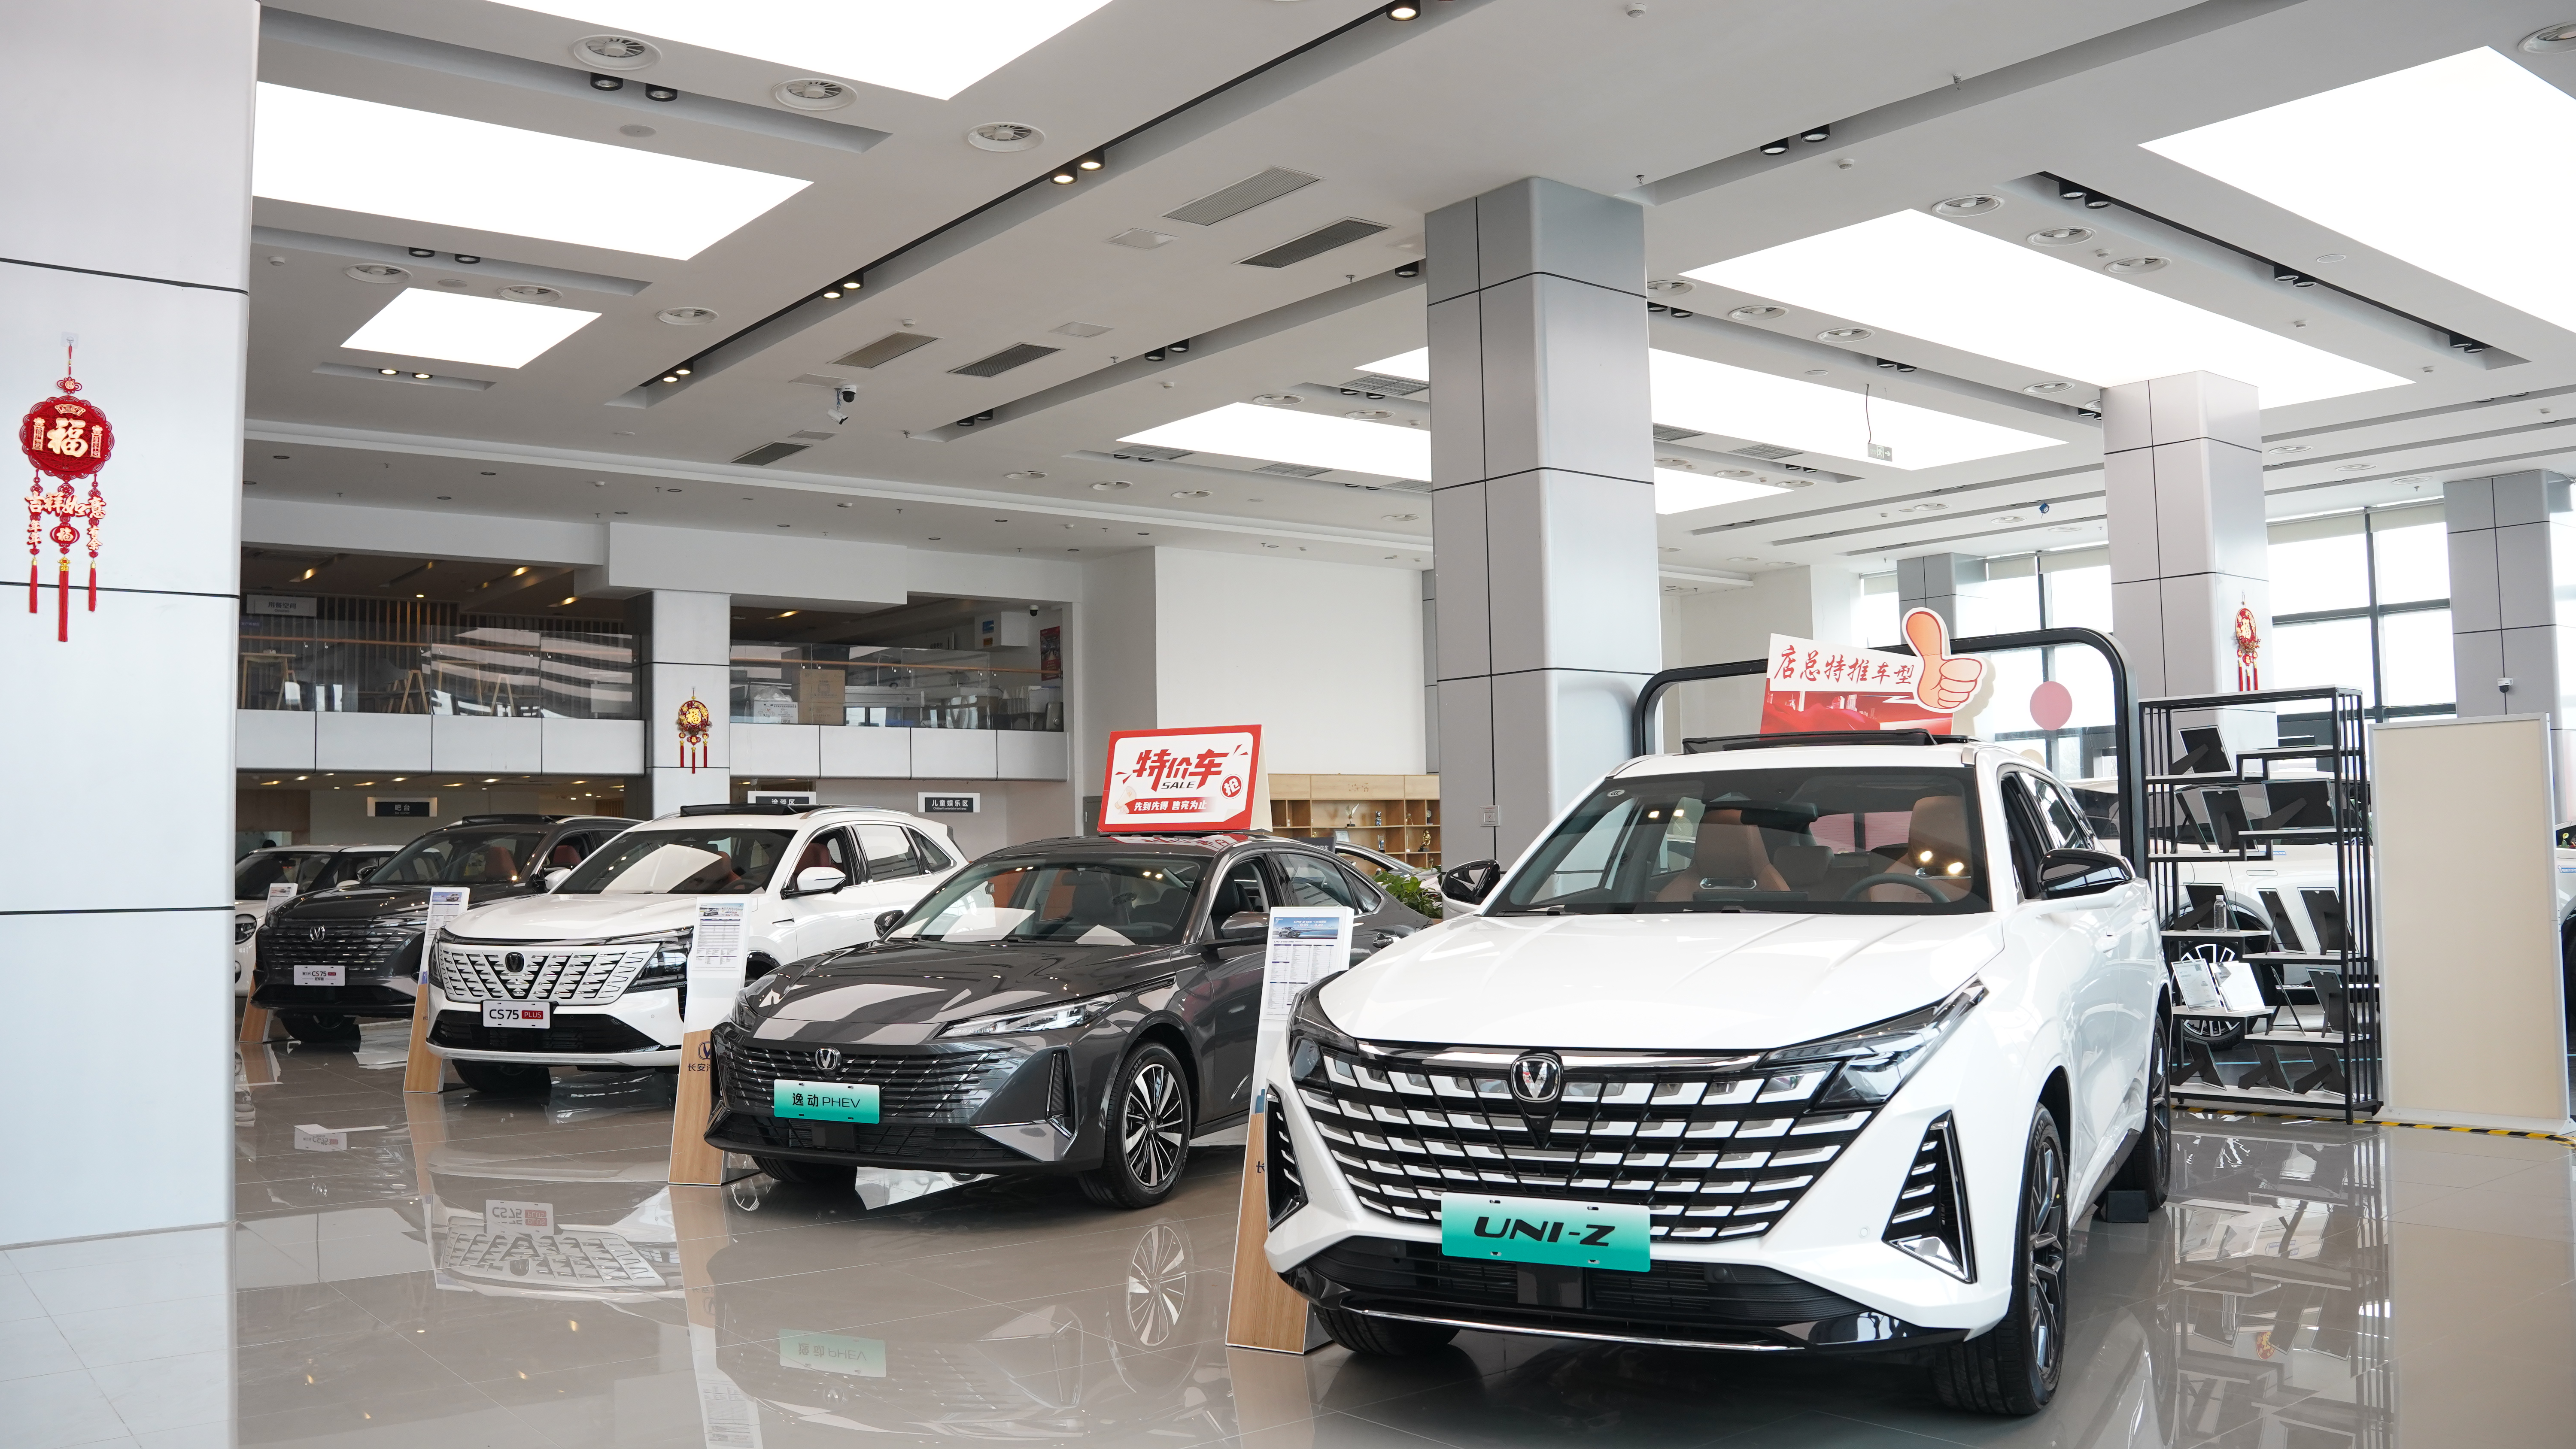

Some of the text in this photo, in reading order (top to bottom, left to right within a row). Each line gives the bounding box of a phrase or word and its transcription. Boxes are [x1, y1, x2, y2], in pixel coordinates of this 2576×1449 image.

[46, 417, 88, 458] 福
[24, 491, 106, 519] 吉祥如意
[56, 527, 74, 542] 福
[1774, 645, 1914, 685] 店总特推车型
[686, 709, 702, 724] 福
[1133, 749, 1230, 792] 特价车
[1160, 781, 1196, 789] SALE
[1224, 777, 1240, 797] 抢
[1133, 800, 1207, 812] 先到先得 售完为止
[489, 1009, 519, 1020] CS75
[792, 1093, 860, 1108] 逸动 PHEV
[1473, 1216, 1616, 1247] UNI-Z
